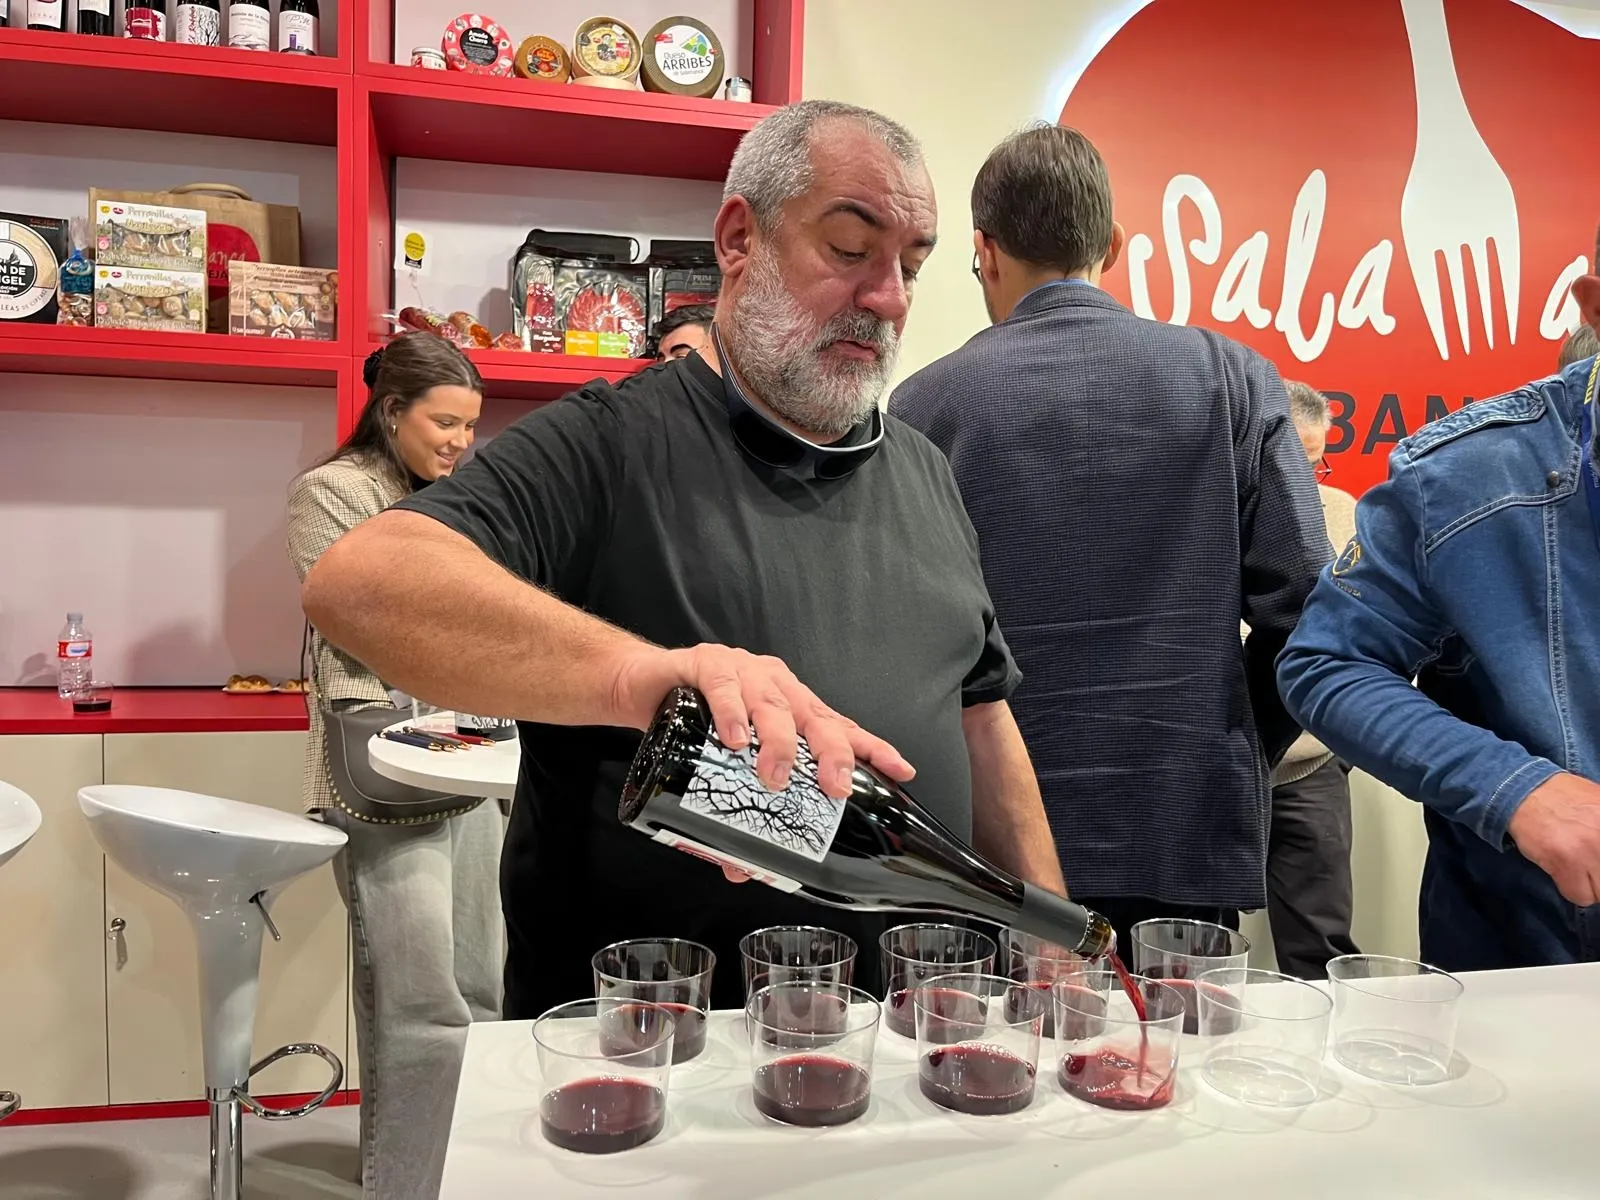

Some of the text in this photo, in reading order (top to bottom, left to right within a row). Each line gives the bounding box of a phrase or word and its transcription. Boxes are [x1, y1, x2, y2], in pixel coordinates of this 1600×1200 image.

[664, 52, 686, 60] Queso
[663, 56, 712, 71] ARRIBES
[10, 266, 26, 276] DE
[0, 275, 26, 286] GEL
